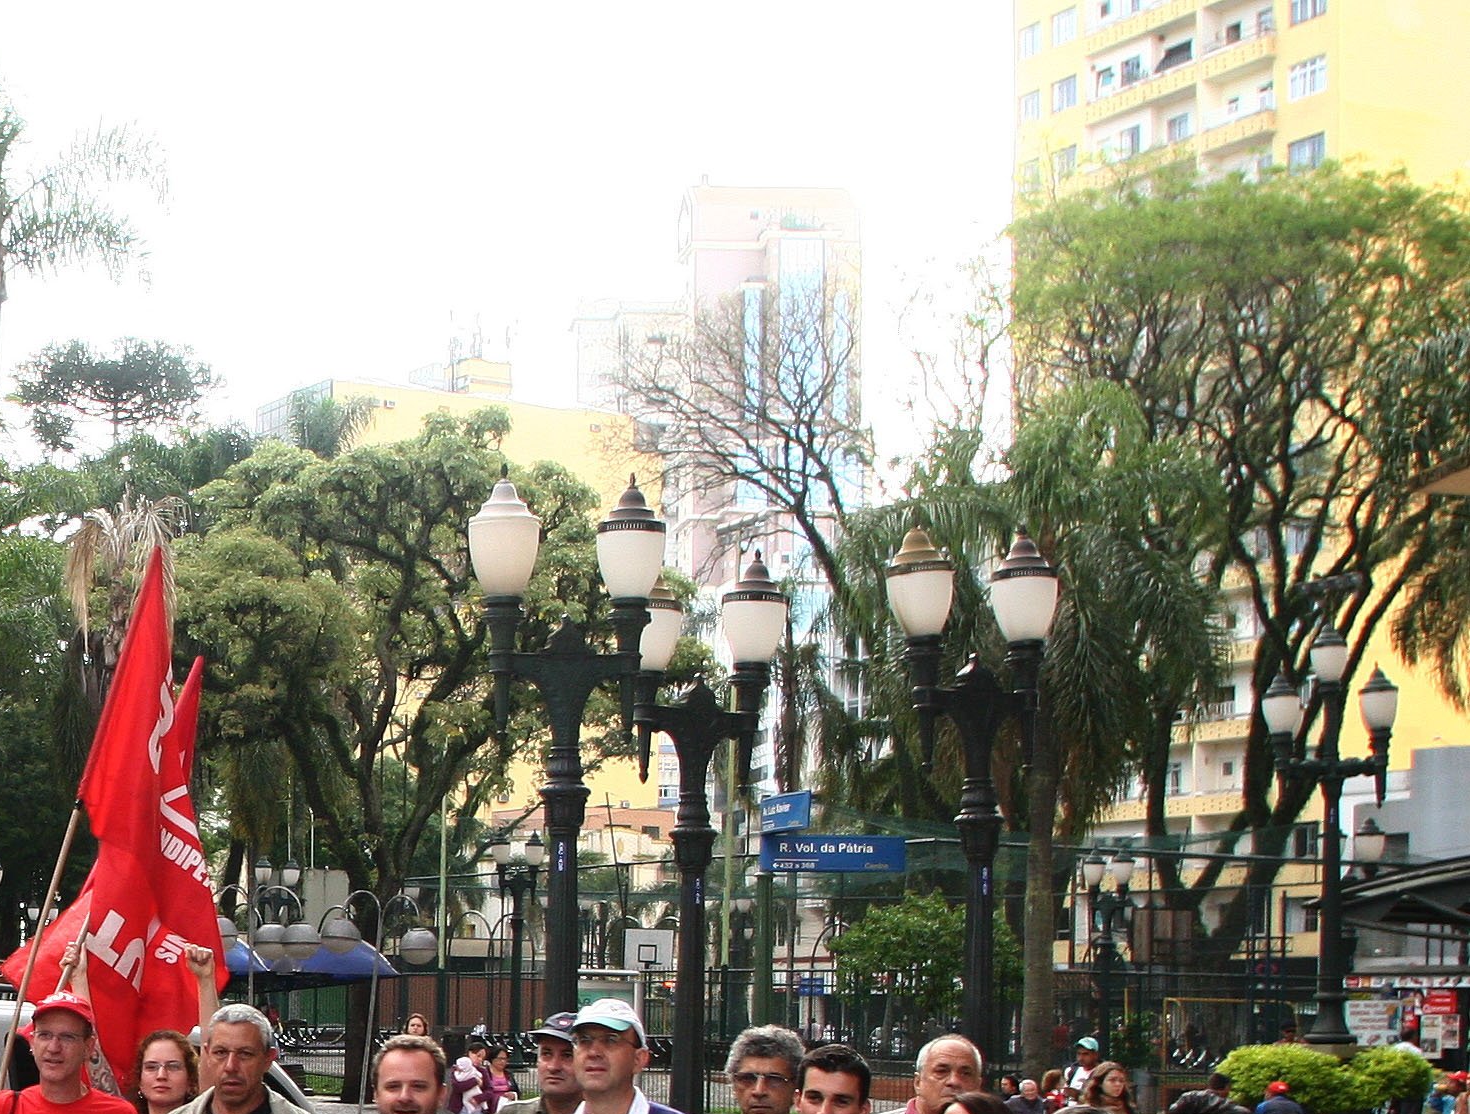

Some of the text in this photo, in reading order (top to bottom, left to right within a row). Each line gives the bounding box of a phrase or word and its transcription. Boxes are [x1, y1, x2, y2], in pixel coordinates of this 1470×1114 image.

[779, 843, 874, 853] R. Vol. da Pátria
